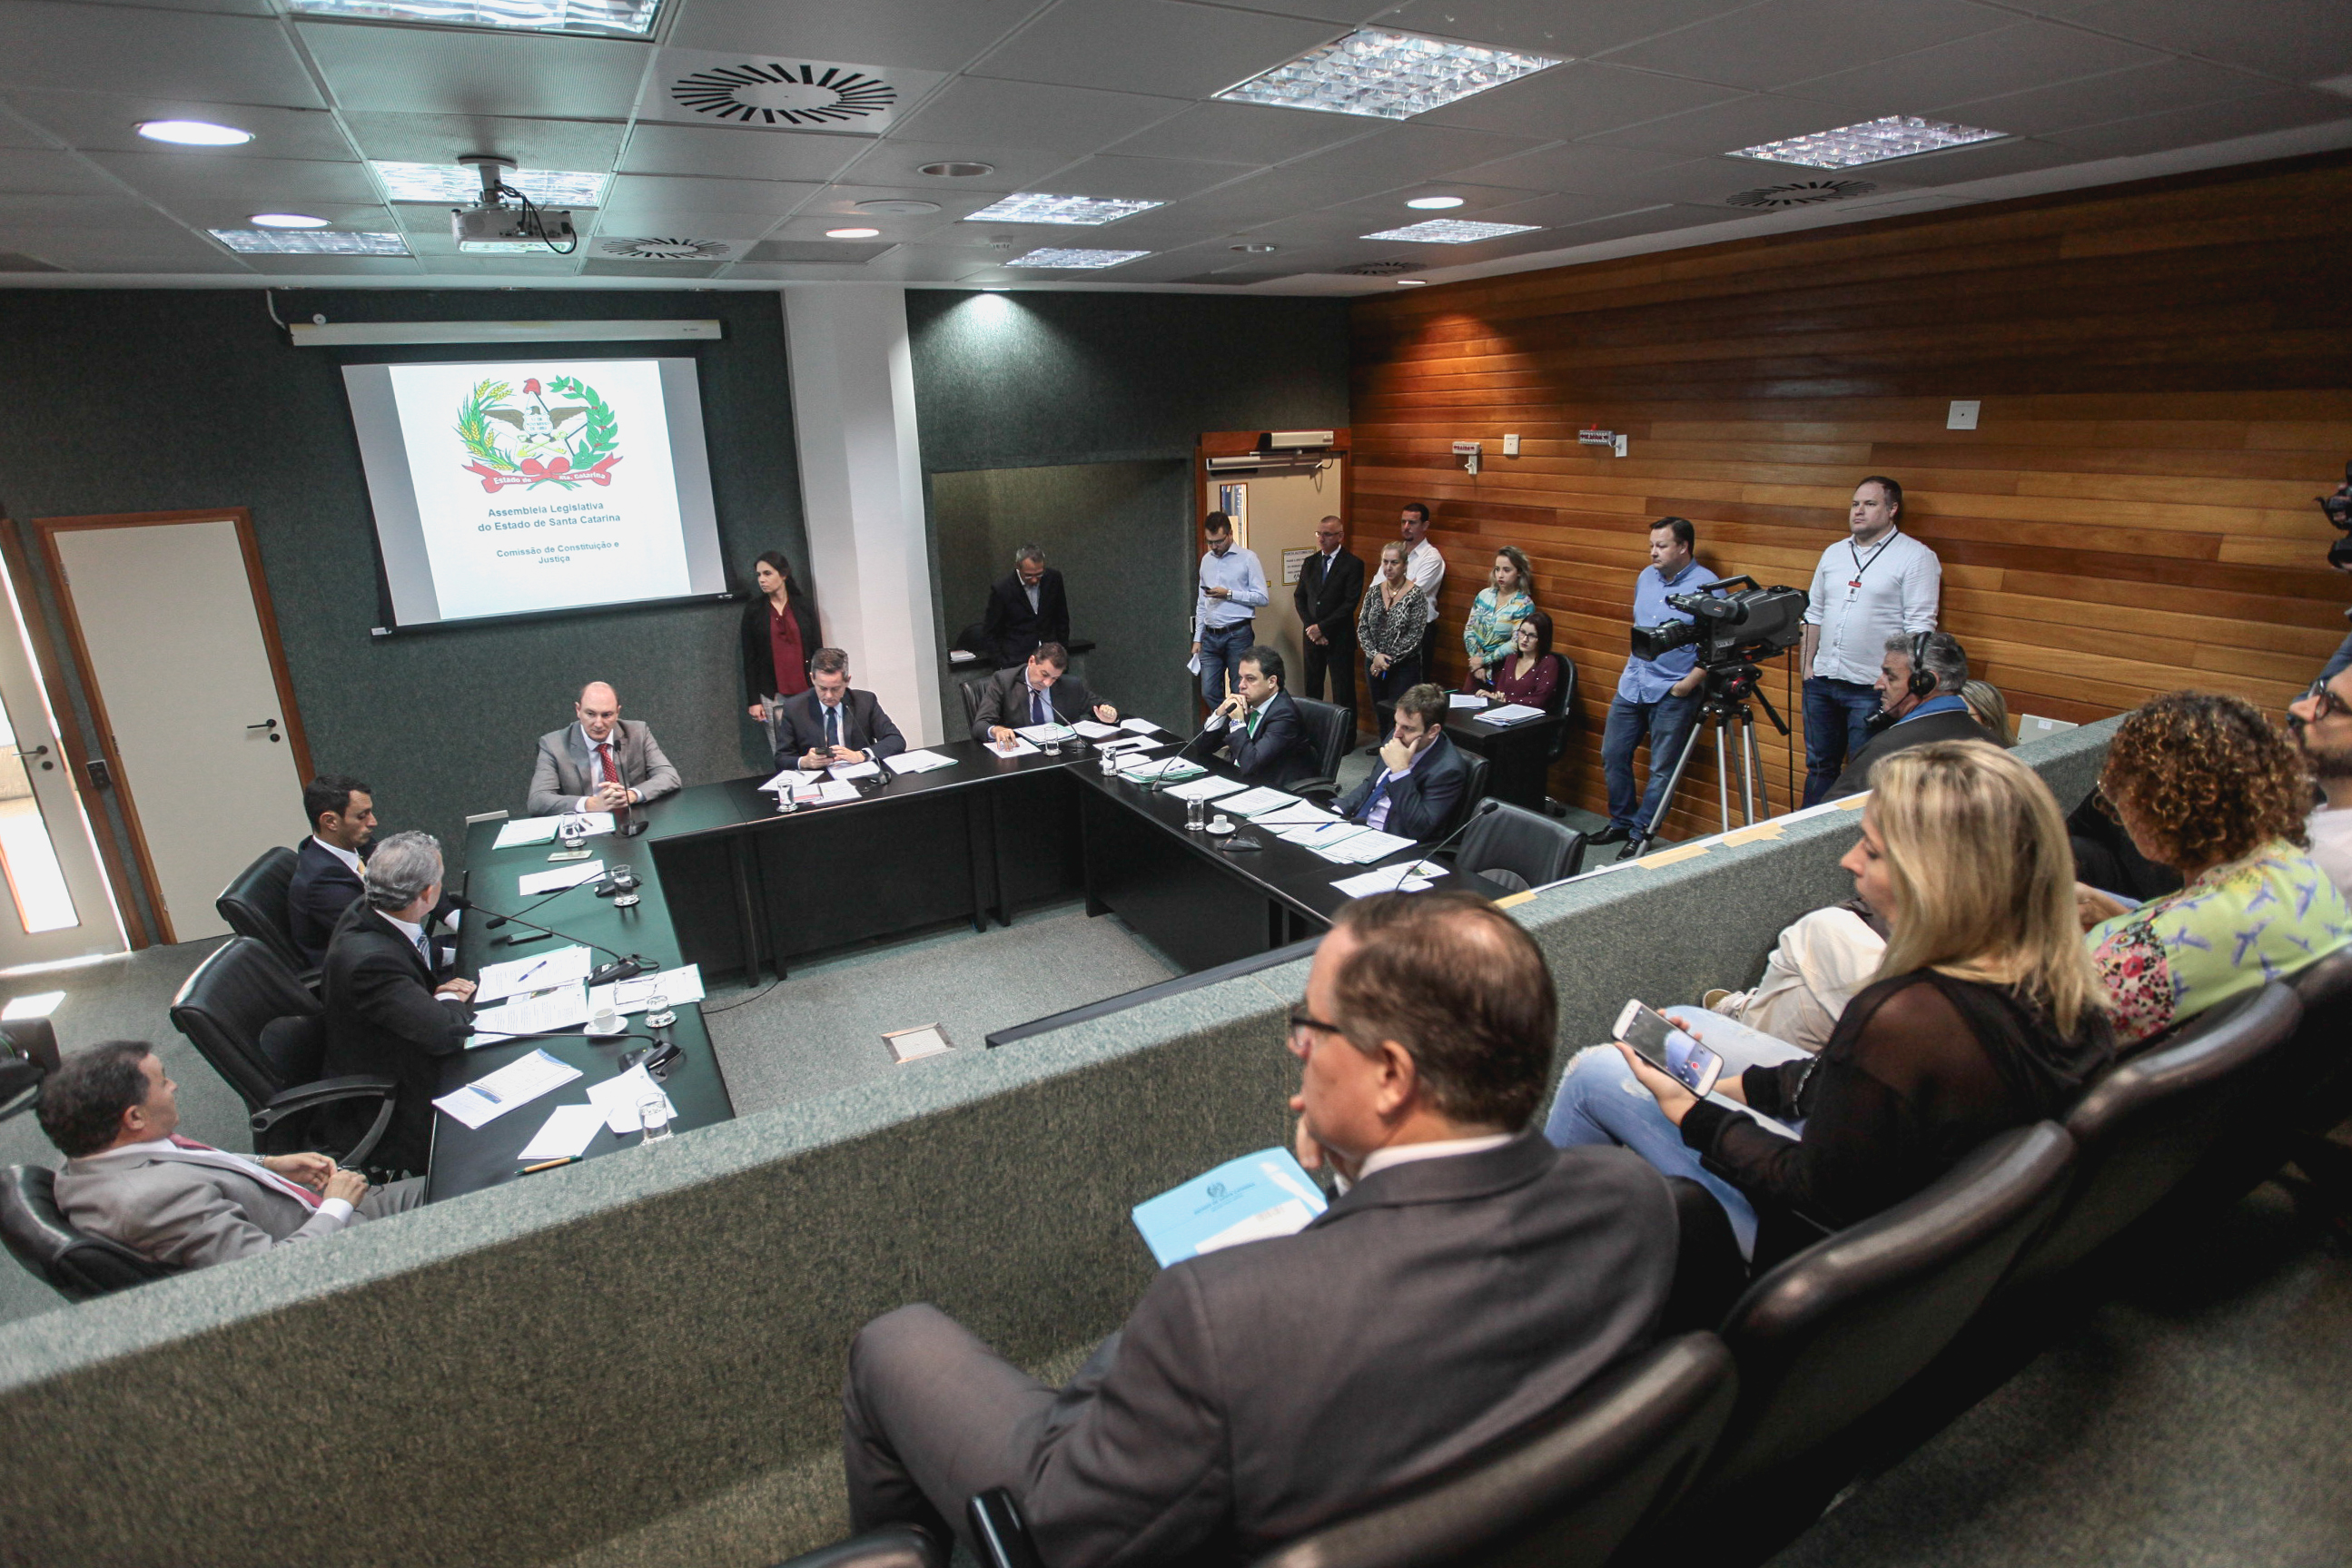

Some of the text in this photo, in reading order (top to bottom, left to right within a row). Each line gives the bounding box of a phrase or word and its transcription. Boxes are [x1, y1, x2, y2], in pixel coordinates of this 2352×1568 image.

[493, 477, 521, 485] Estado
[574, 471, 606, 479] Catarina
[488, 502, 604, 518] Assembleia Legislativa
[478, 514, 621, 532] do Estado de Santa Catarina
[496, 547, 542, 557] Comissão
[557, 541, 612, 552] Constituição
[538, 555, 571, 564] Justiça
